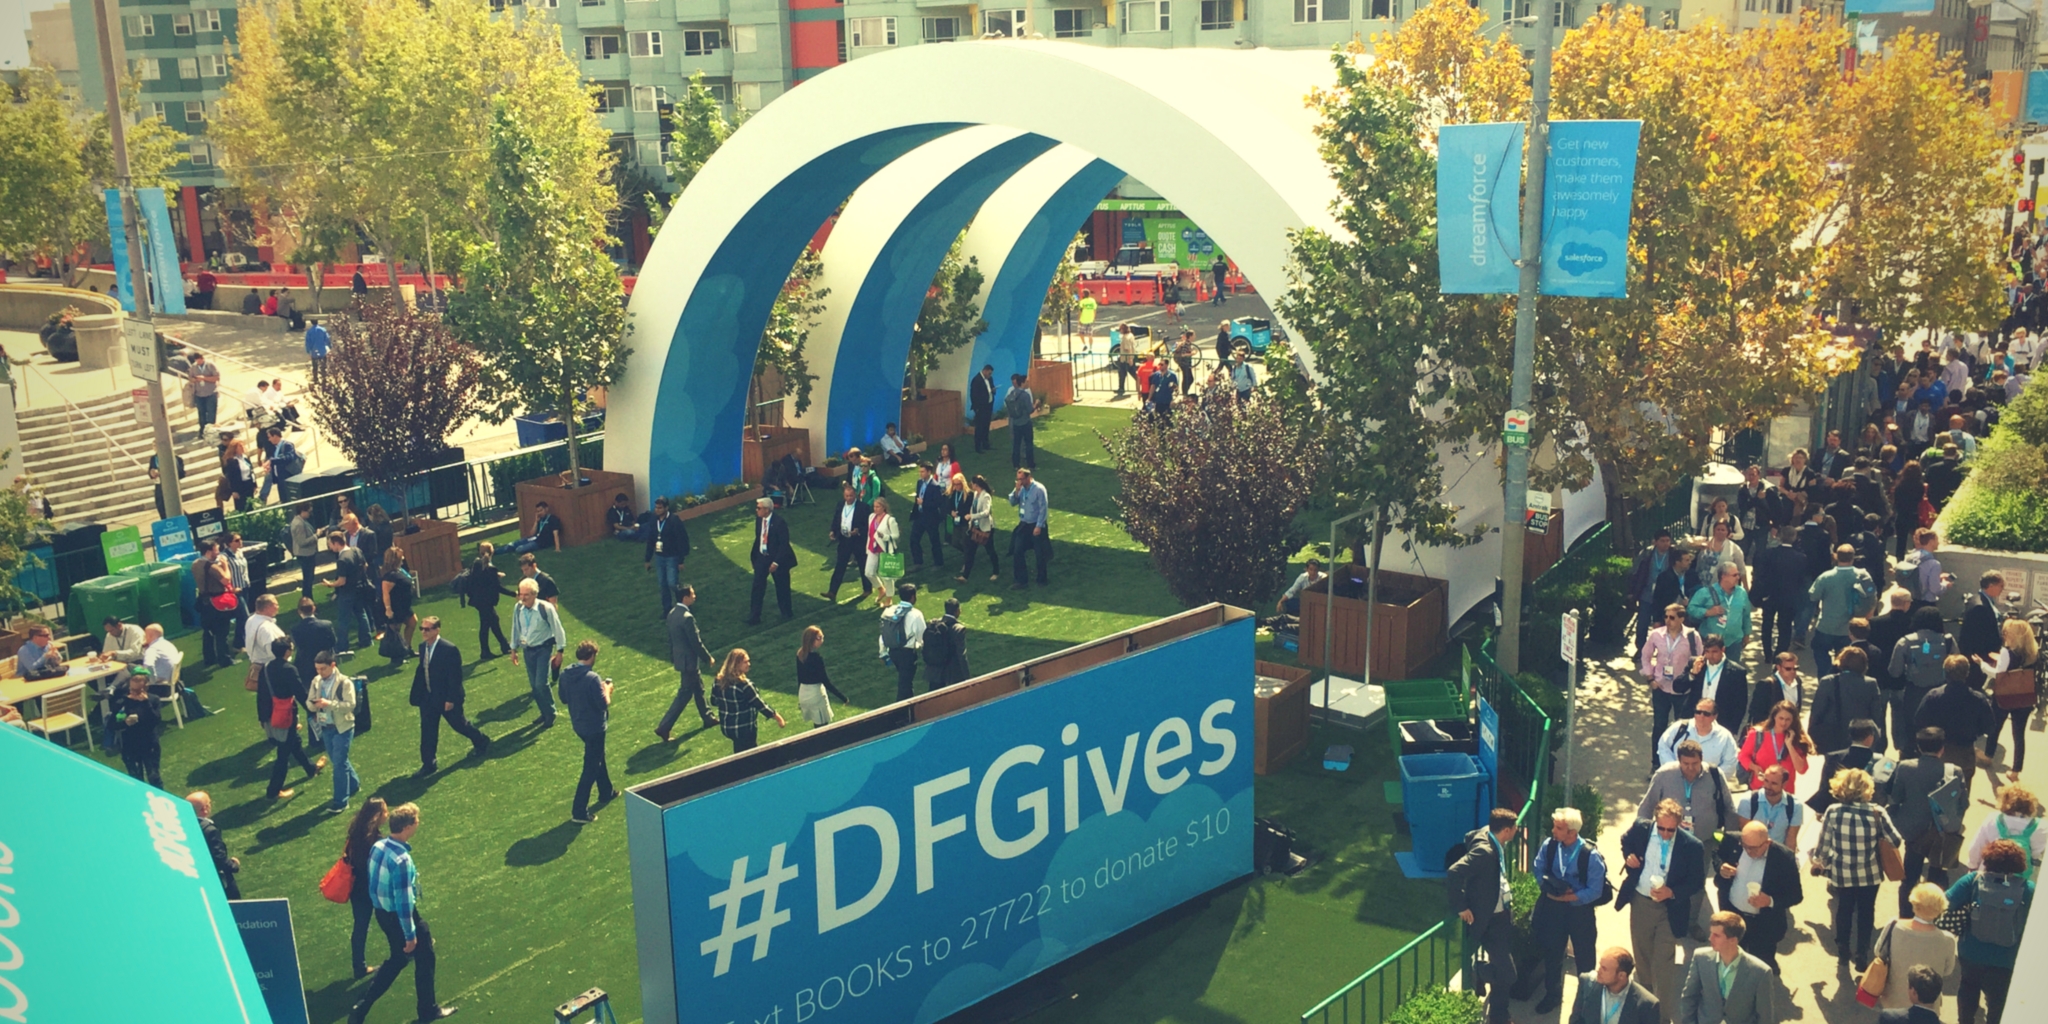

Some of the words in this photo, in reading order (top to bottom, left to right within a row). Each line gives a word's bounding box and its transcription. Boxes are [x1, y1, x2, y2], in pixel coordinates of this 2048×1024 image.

[1557, 138, 1579, 150] Get
[1583, 140, 1609, 150] new
[1555, 157, 1622, 168] customers,
[1555, 173, 1587, 184] make
[1590, 173, 1623, 184] them
[1552, 190, 1620, 204] awesomely
[1468, 153, 1490, 267] dreamforce
[1551, 206, 1588, 221] happy
[1157, 232, 1176, 241] QUOTE
[1157, 243, 1176, 253] CASH
[1564, 253, 1603, 263] salesforce
[130, 344, 150, 357] MUST
[1506, 435, 1525, 444] BUS
[1534, 512, 1549, 521] BUS
[1530, 519, 1548, 529] STOP
[700, 698, 1237, 979] #DFGives
[795, 944, 914, 1023] BOOKS
[922, 937, 951, 965] to
[960, 884, 1053, 951] 27722
[1060, 879, 1087, 907] to
[1094, 832, 1179, 891] donate
[1185, 806, 1231, 849] $10
